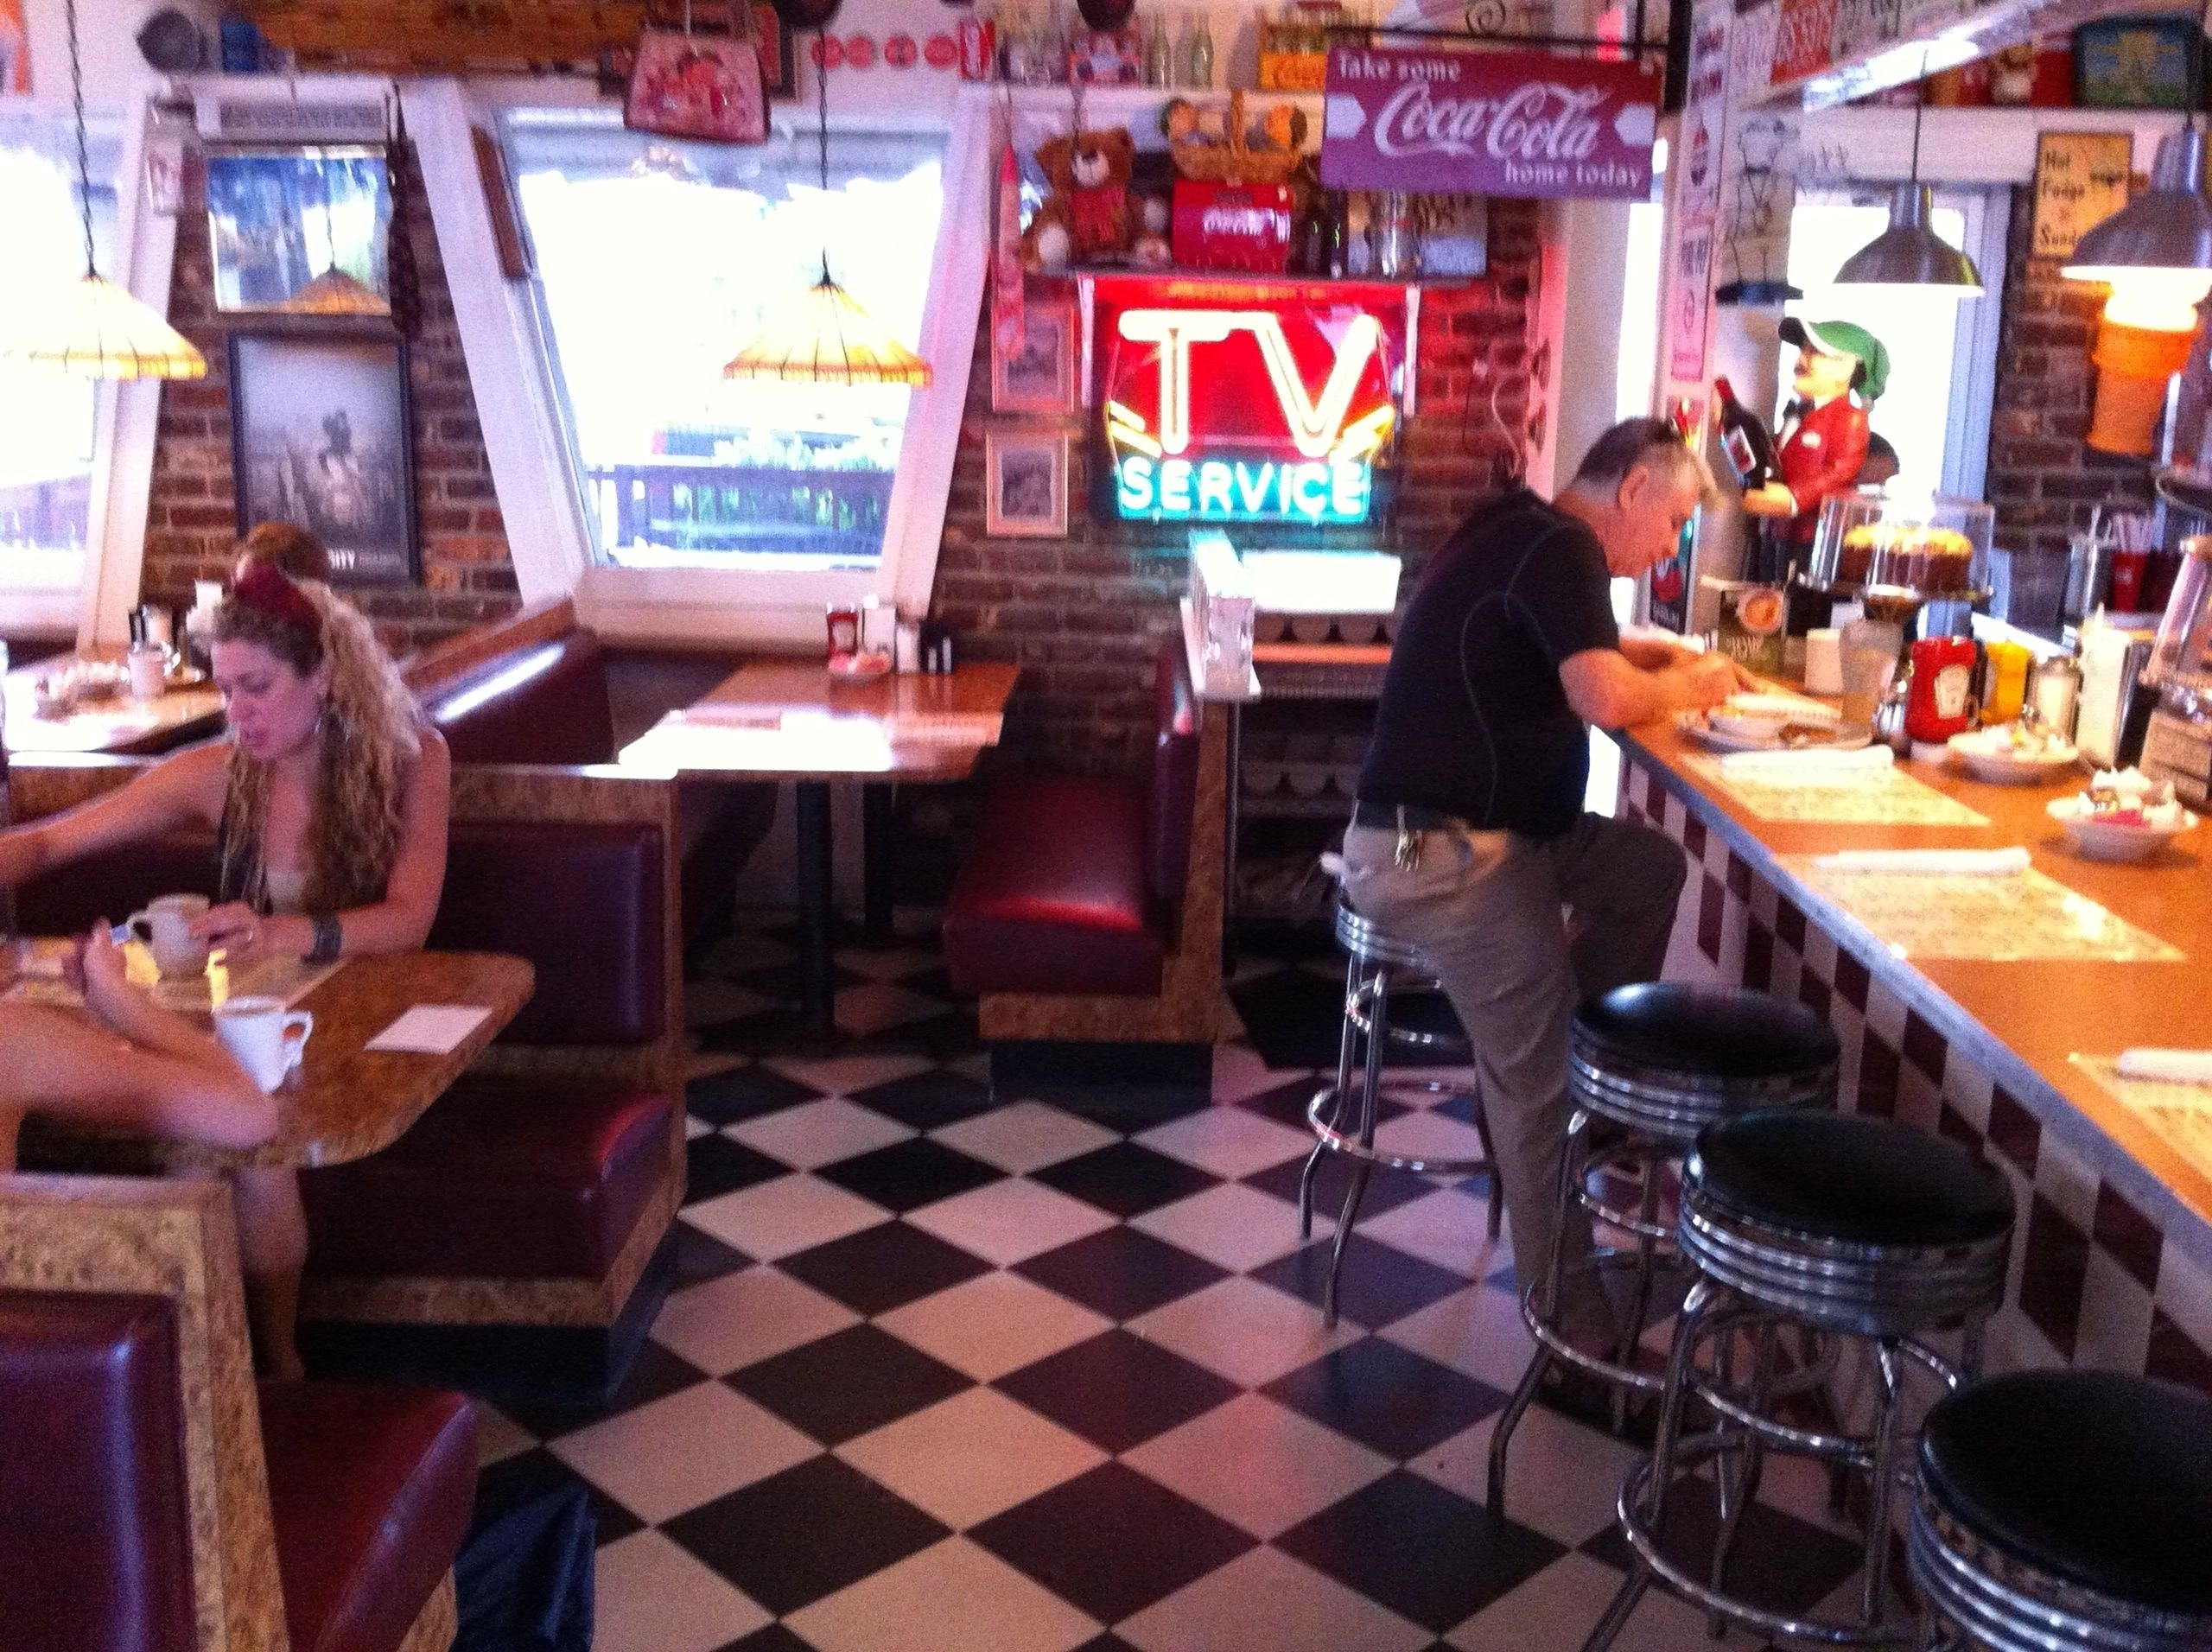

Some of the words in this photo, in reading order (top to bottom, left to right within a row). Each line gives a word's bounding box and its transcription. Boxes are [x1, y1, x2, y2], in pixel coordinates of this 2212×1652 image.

[1338, 51, 1390, 80] Take
[1398, 58, 1461, 82] some
[1505, 158, 1569, 185] home
[1576, 158, 1641, 187] today
[1118, 308, 1379, 457] TV
[1121, 455, 1365, 518] SERVICE
